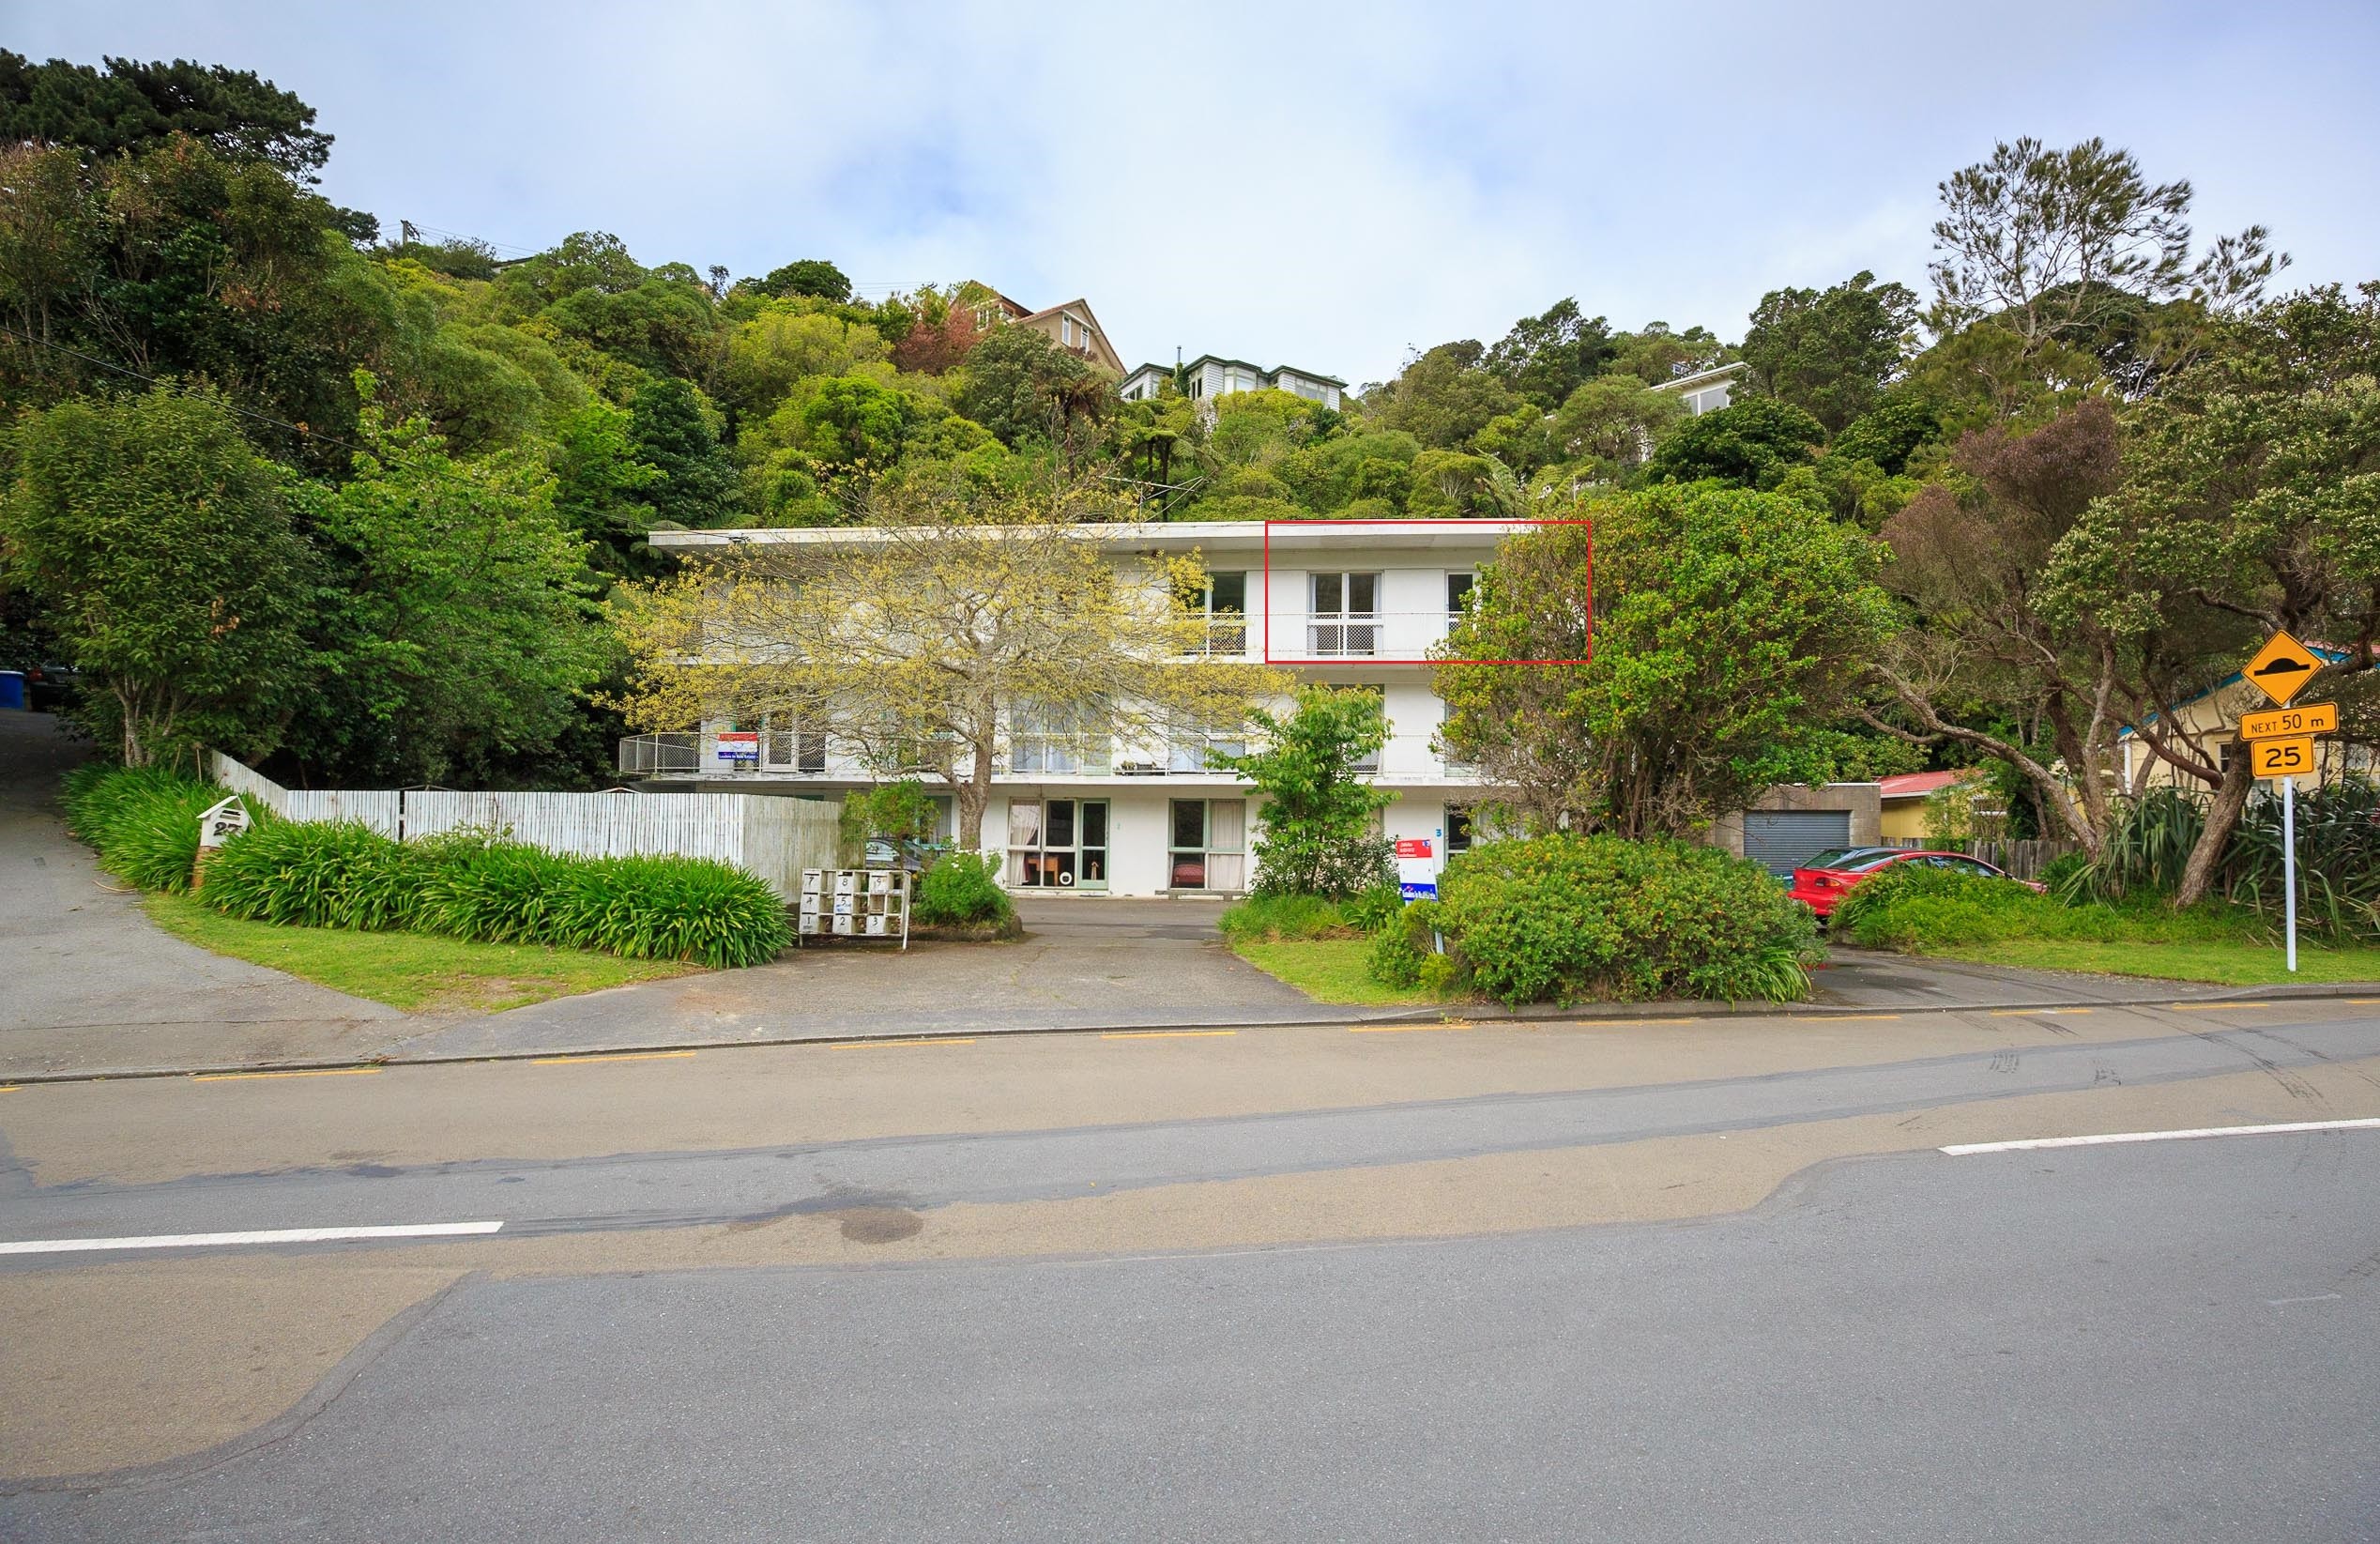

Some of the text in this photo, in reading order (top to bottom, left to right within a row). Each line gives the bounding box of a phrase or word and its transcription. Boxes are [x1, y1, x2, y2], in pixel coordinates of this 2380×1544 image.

[2250, 713, 2324, 733] NEXT 50 m
[2266, 746, 2301, 768] 25
[1436, 829, 1442, 837] 3
[808, 877, 815, 887] 7
[842, 878, 848, 887] 8
[877, 878, 882, 887] 9
[841, 896, 847, 906] 5
[839, 916, 846, 925] 2
[872, 916, 878, 926] 3
